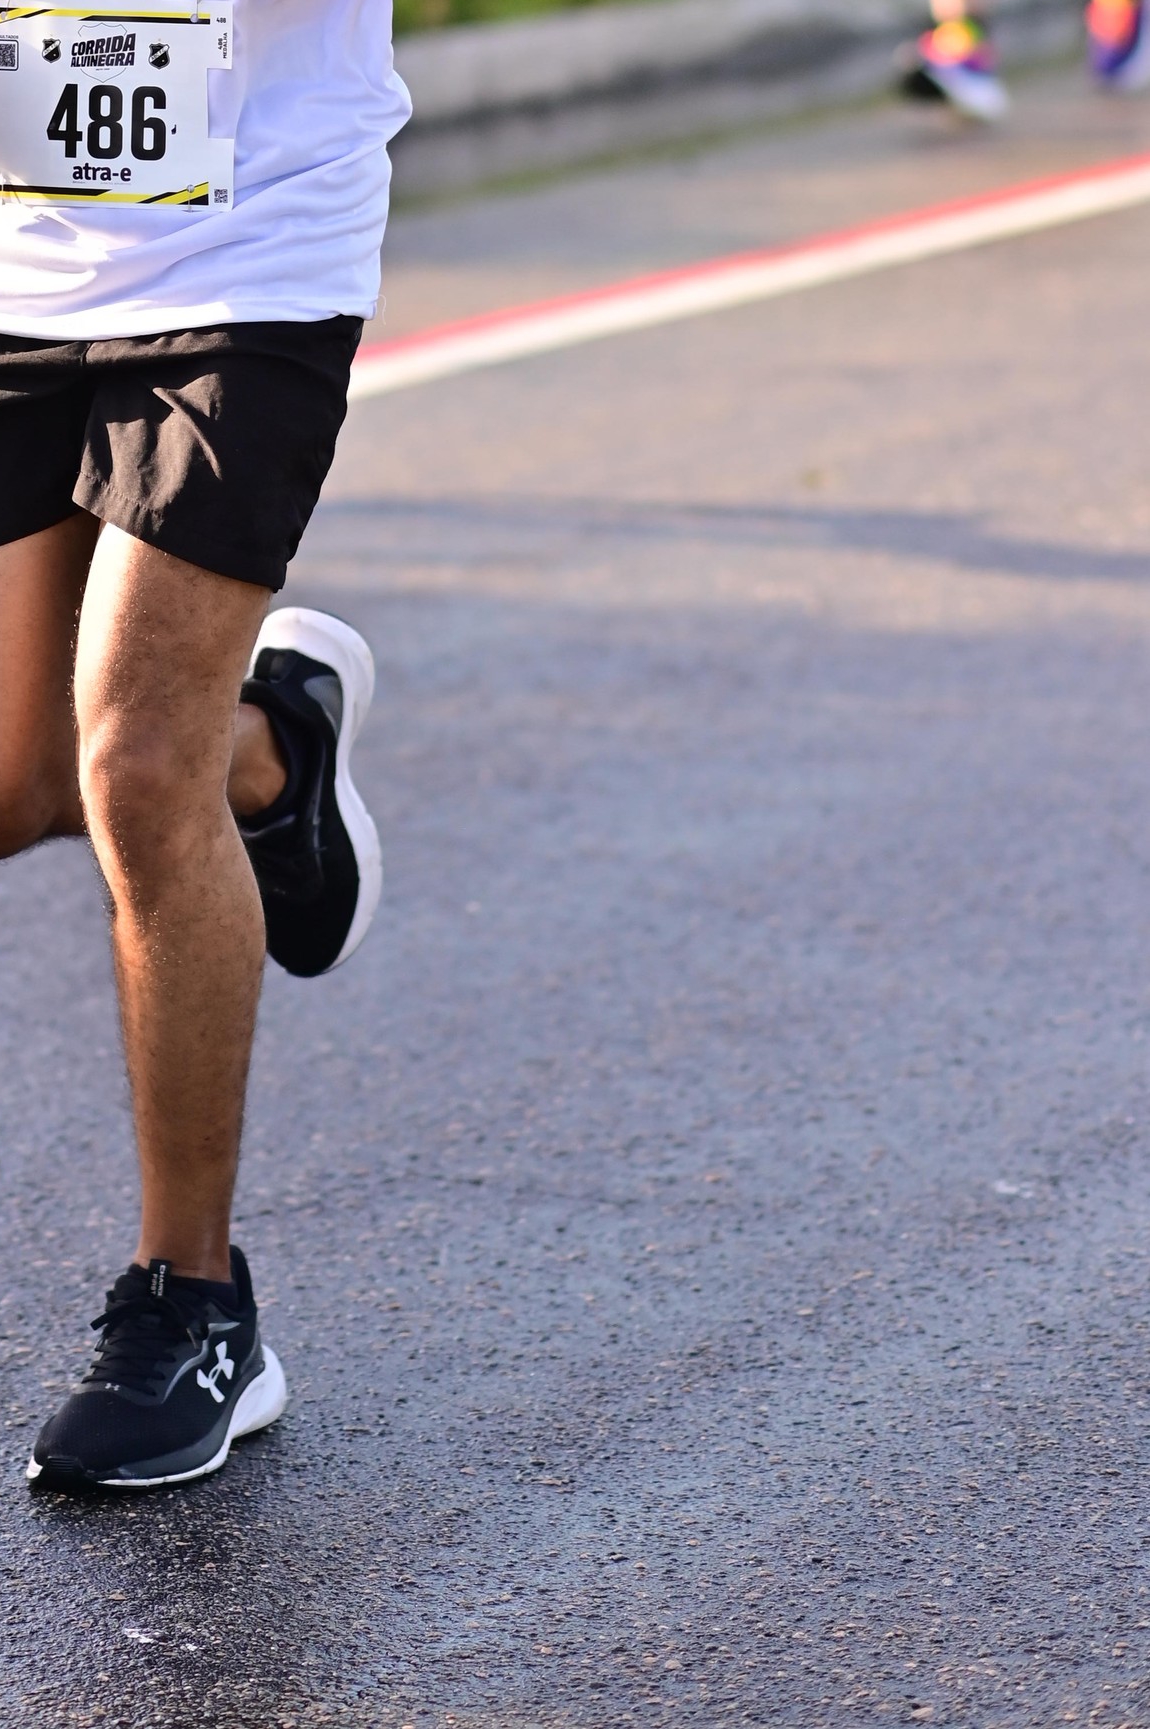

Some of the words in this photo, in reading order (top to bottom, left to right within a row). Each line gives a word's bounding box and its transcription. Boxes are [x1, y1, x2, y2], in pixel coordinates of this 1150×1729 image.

[71, 33, 136, 56] CORRIDA
[70, 52, 135, 67] ALVINEGRA
[47, 83, 167, 161] 486
[72, 162, 132, 182] atra-e
